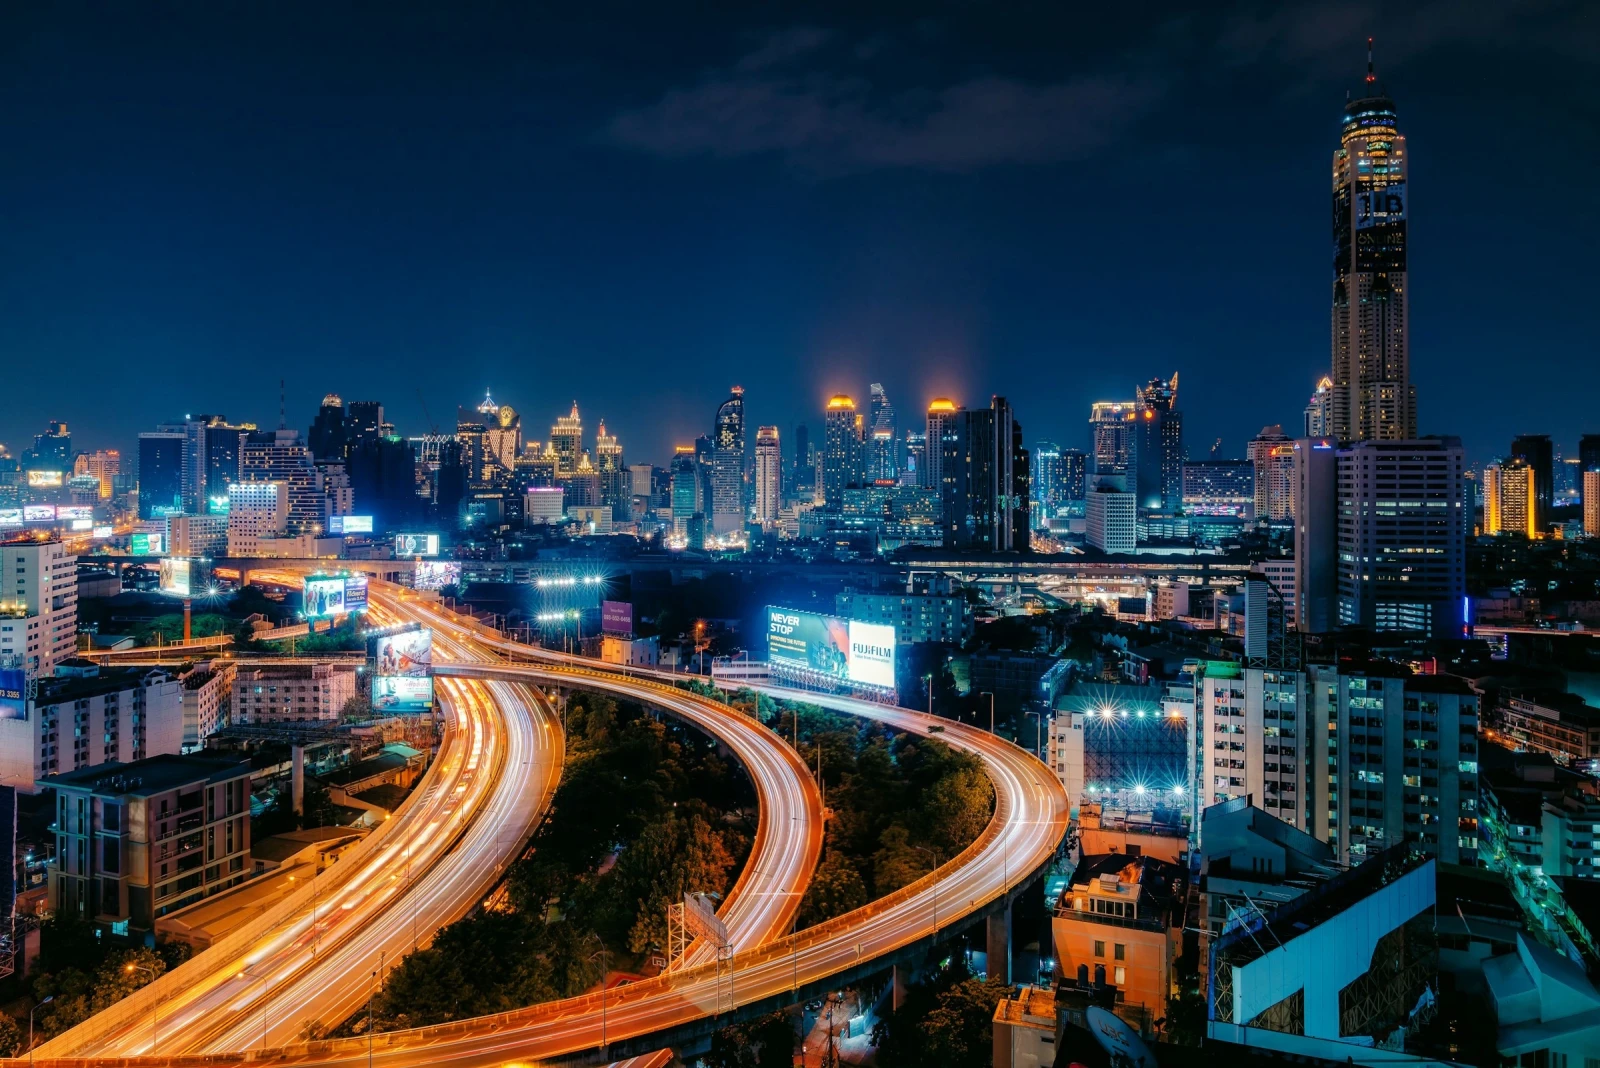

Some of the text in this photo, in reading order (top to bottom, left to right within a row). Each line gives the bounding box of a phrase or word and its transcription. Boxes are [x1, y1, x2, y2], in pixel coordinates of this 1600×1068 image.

[1359, 194, 1403, 224] JIB
[1358, 235, 1404, 245] ONLINE
[771, 612, 799, 626] NEVER
[770, 623, 793, 635] STOP
[853, 643, 891, 658] FUJIFILM
